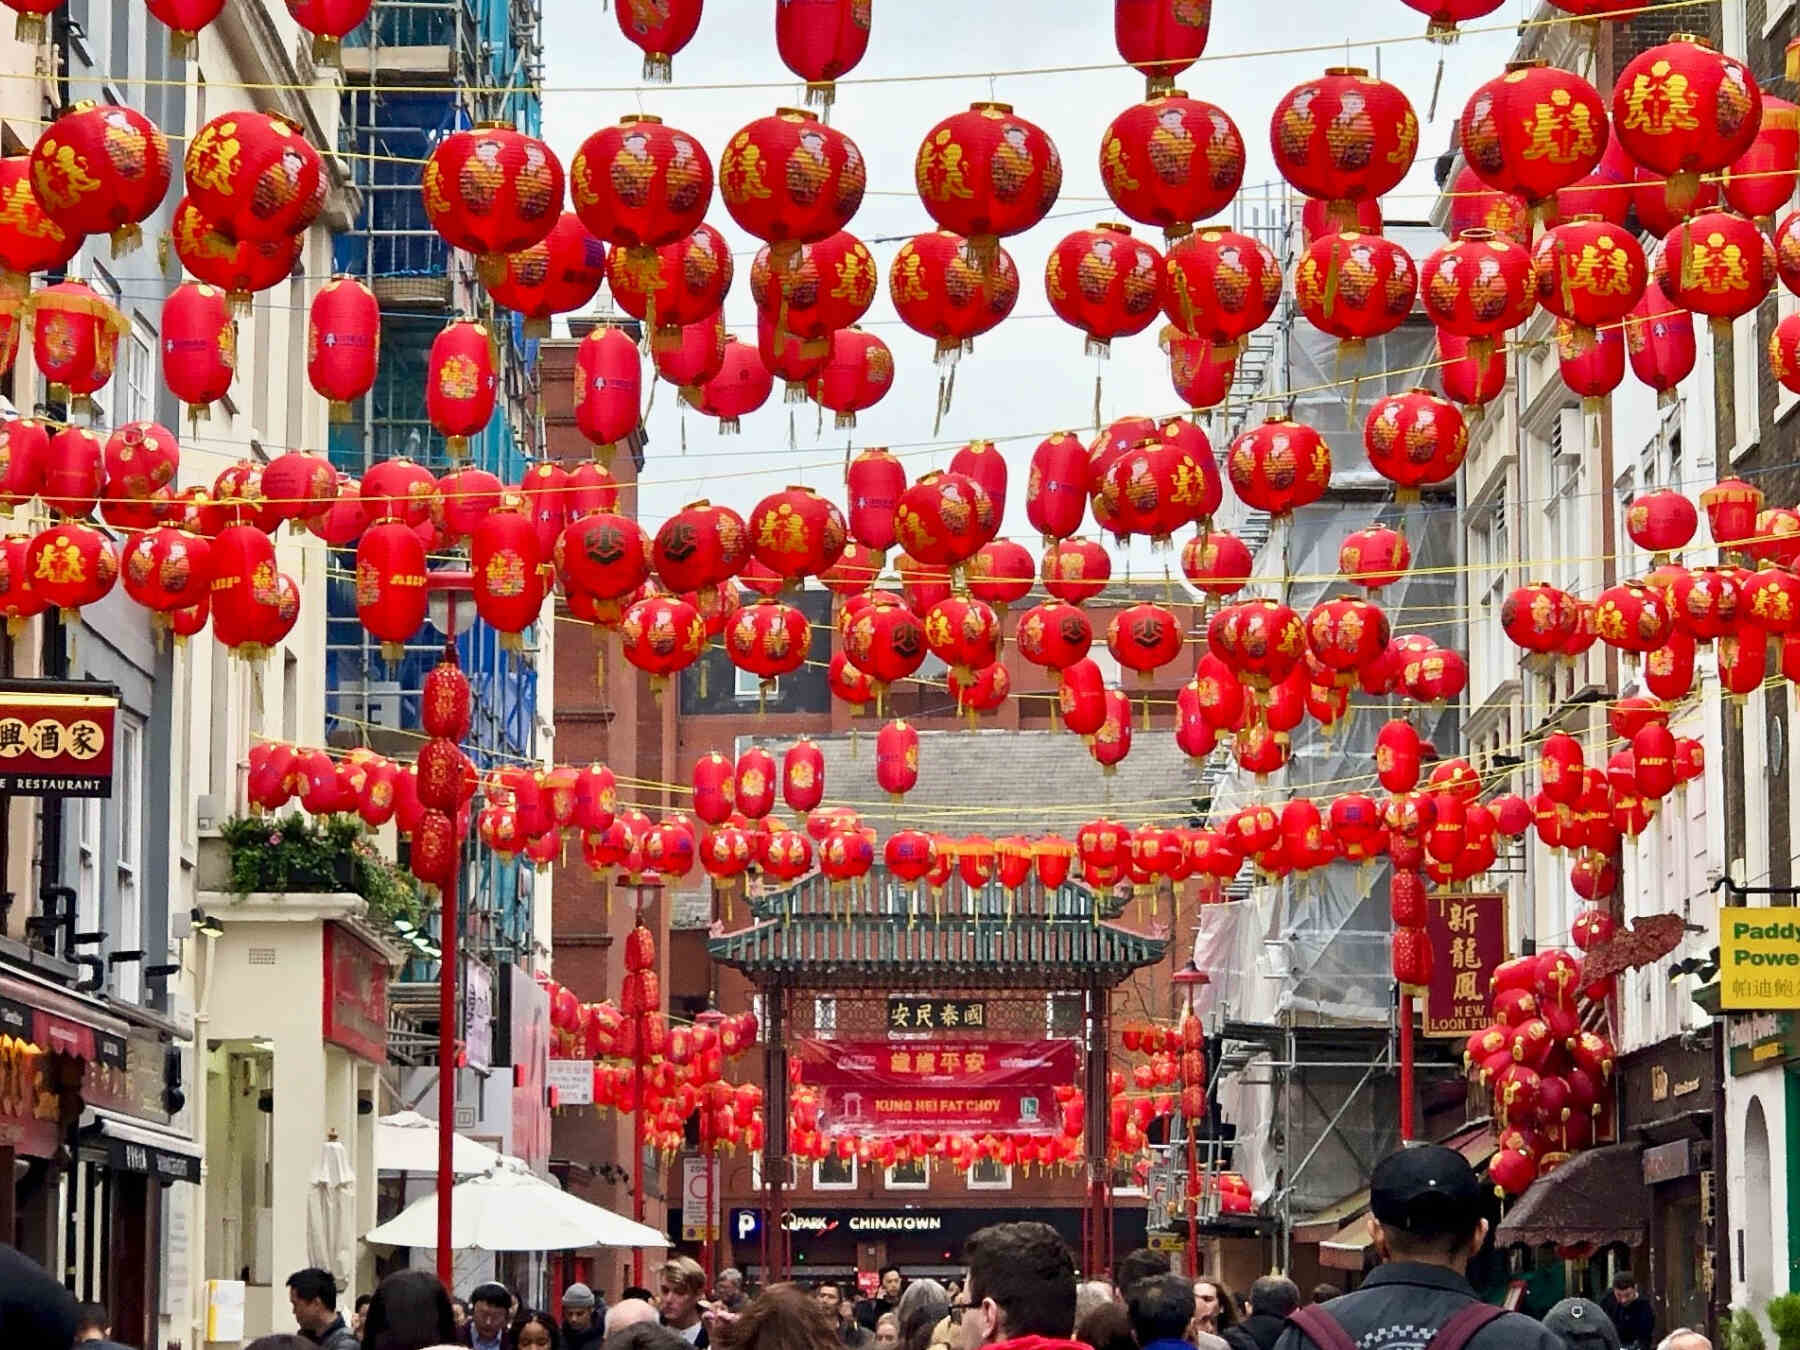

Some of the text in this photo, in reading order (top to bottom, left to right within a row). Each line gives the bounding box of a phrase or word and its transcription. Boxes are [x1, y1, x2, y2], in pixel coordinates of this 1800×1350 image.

[16, 778, 101, 790] RESTAURANT
[1733, 949, 1800, 966] Powe
[1454, 1005, 1485, 1018] NEW
[1431, 1019, 1466, 1030] LOON
[875, 1099, 1000, 1112] KUNG HEI FAT CHOY
[738, 1210, 756, 1239] P
[849, 1217, 941, 1230] CHINATOWN
